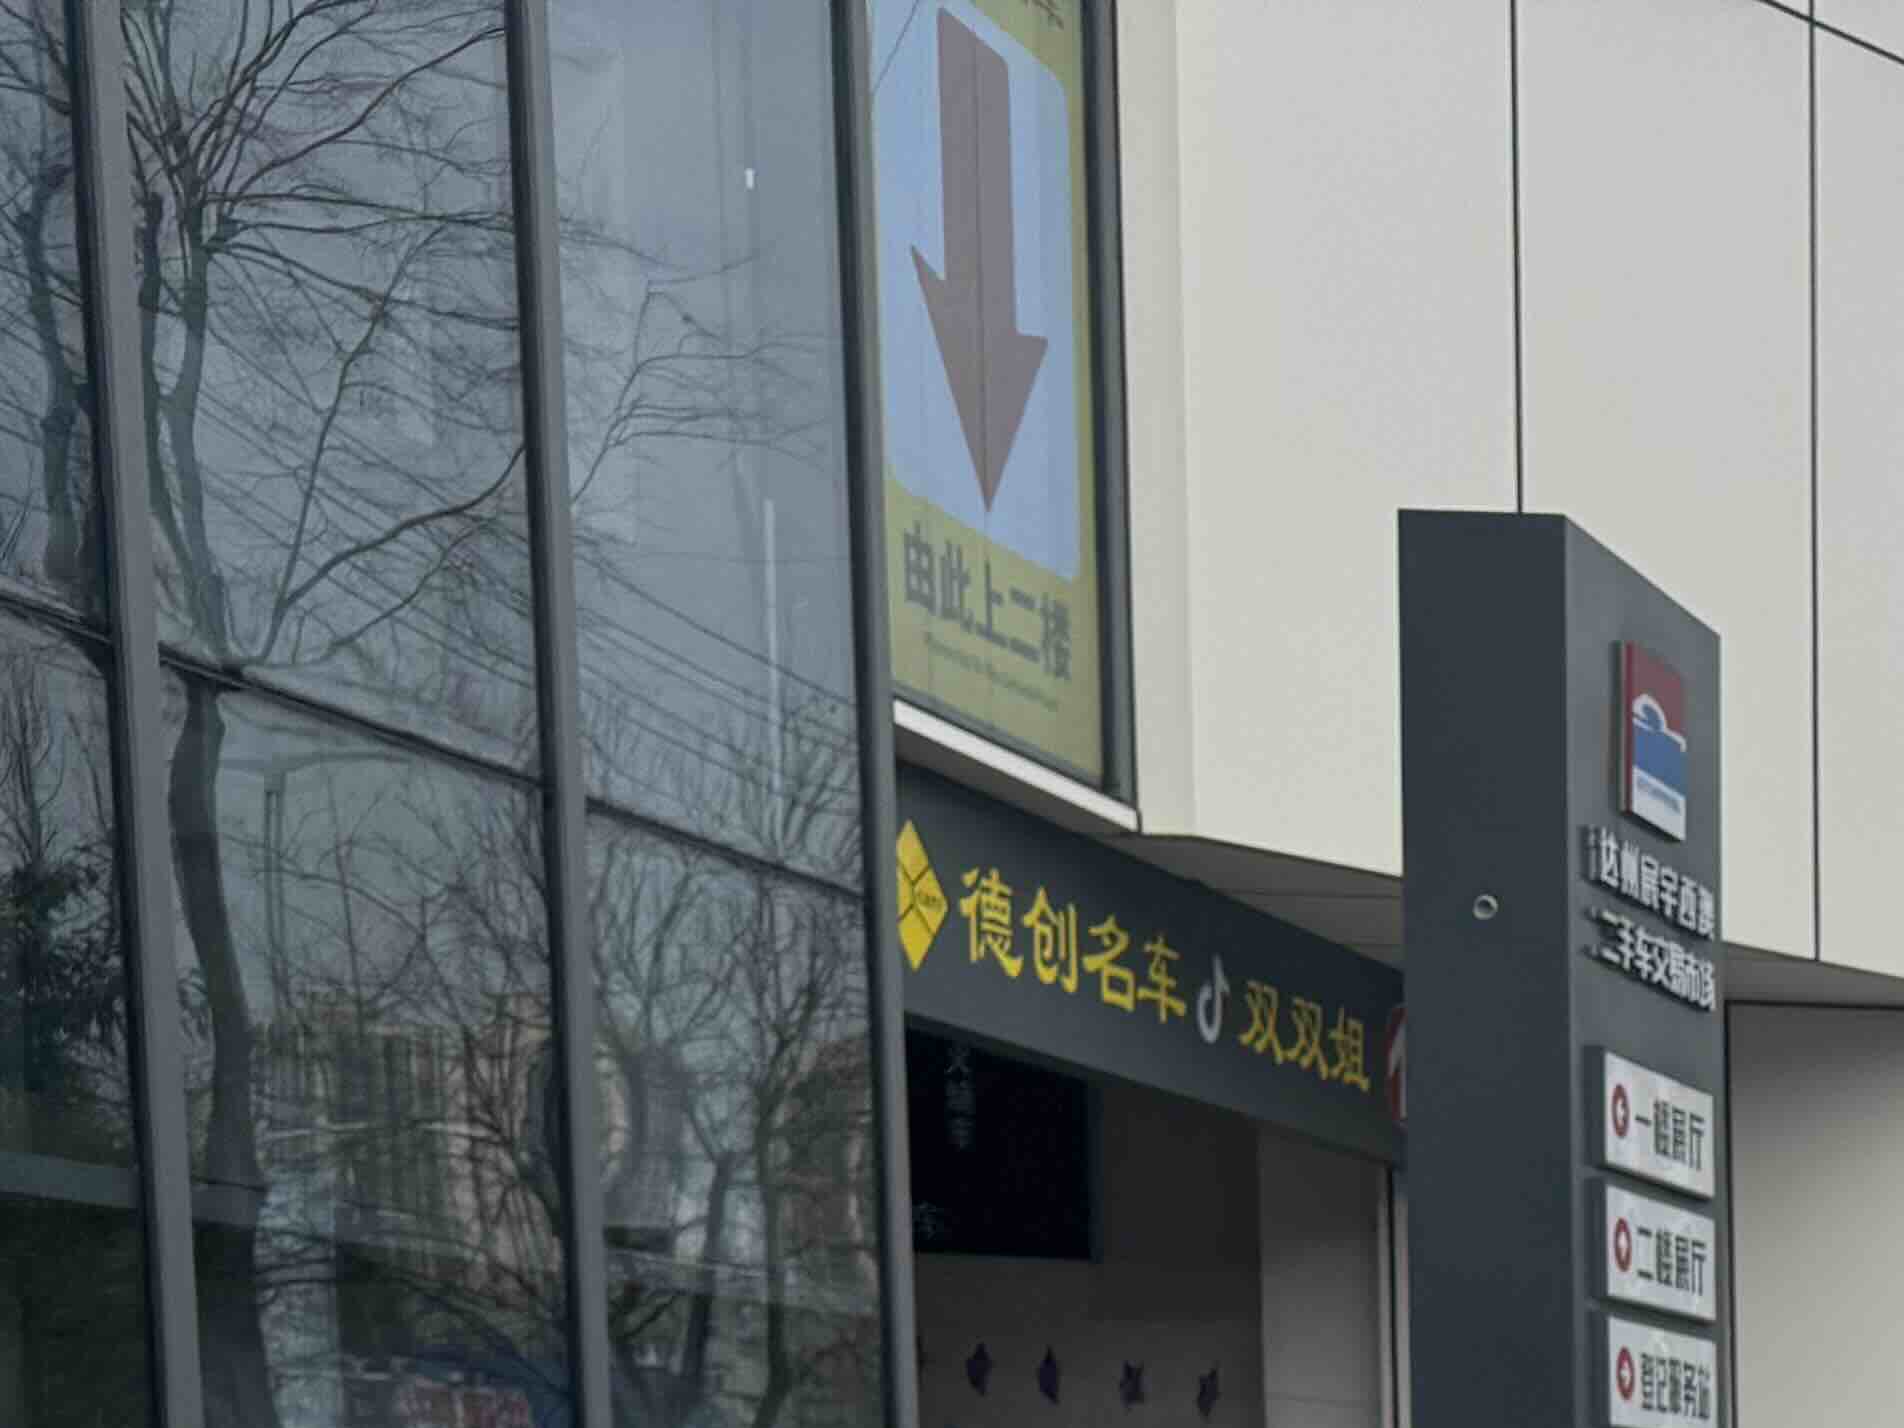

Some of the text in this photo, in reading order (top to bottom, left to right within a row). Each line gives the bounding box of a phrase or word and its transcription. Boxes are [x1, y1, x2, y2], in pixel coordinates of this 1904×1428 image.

[903, 521, 1071, 682] 由此上二楼
[960, 866, 1371, 1093] 德创名车 双双姐
[1599, 908, 1716, 1011] 二手车交易市场
[1637, 1226, 1707, 1296] 二楼展厅
